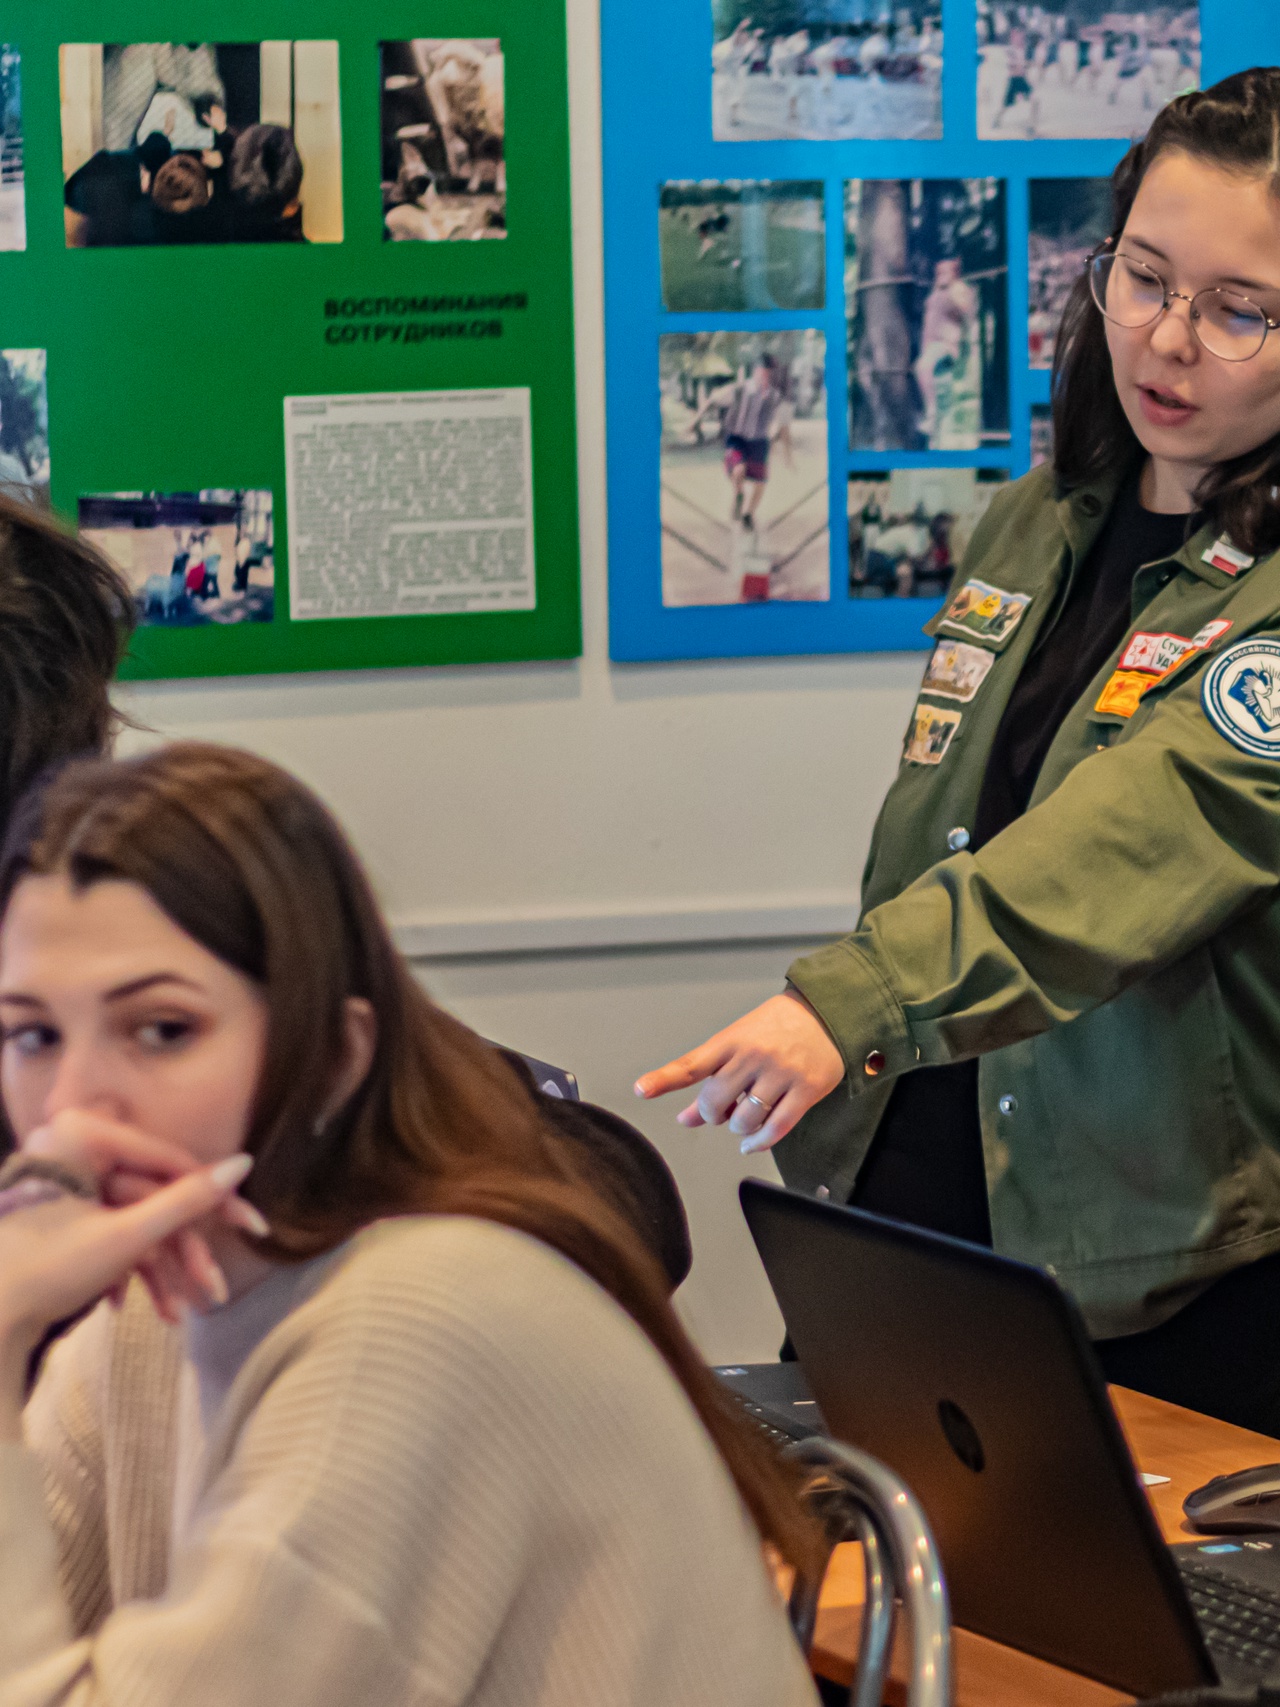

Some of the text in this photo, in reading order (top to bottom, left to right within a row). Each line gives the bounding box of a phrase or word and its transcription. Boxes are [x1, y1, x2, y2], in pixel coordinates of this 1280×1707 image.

[324, 293, 528, 318] ВОСПОМИНАНИЯ
[325, 321, 502, 344] СОТРУДНИКОВ
[1229, 645, 1280, 661] РОССИЙСКИЕ
